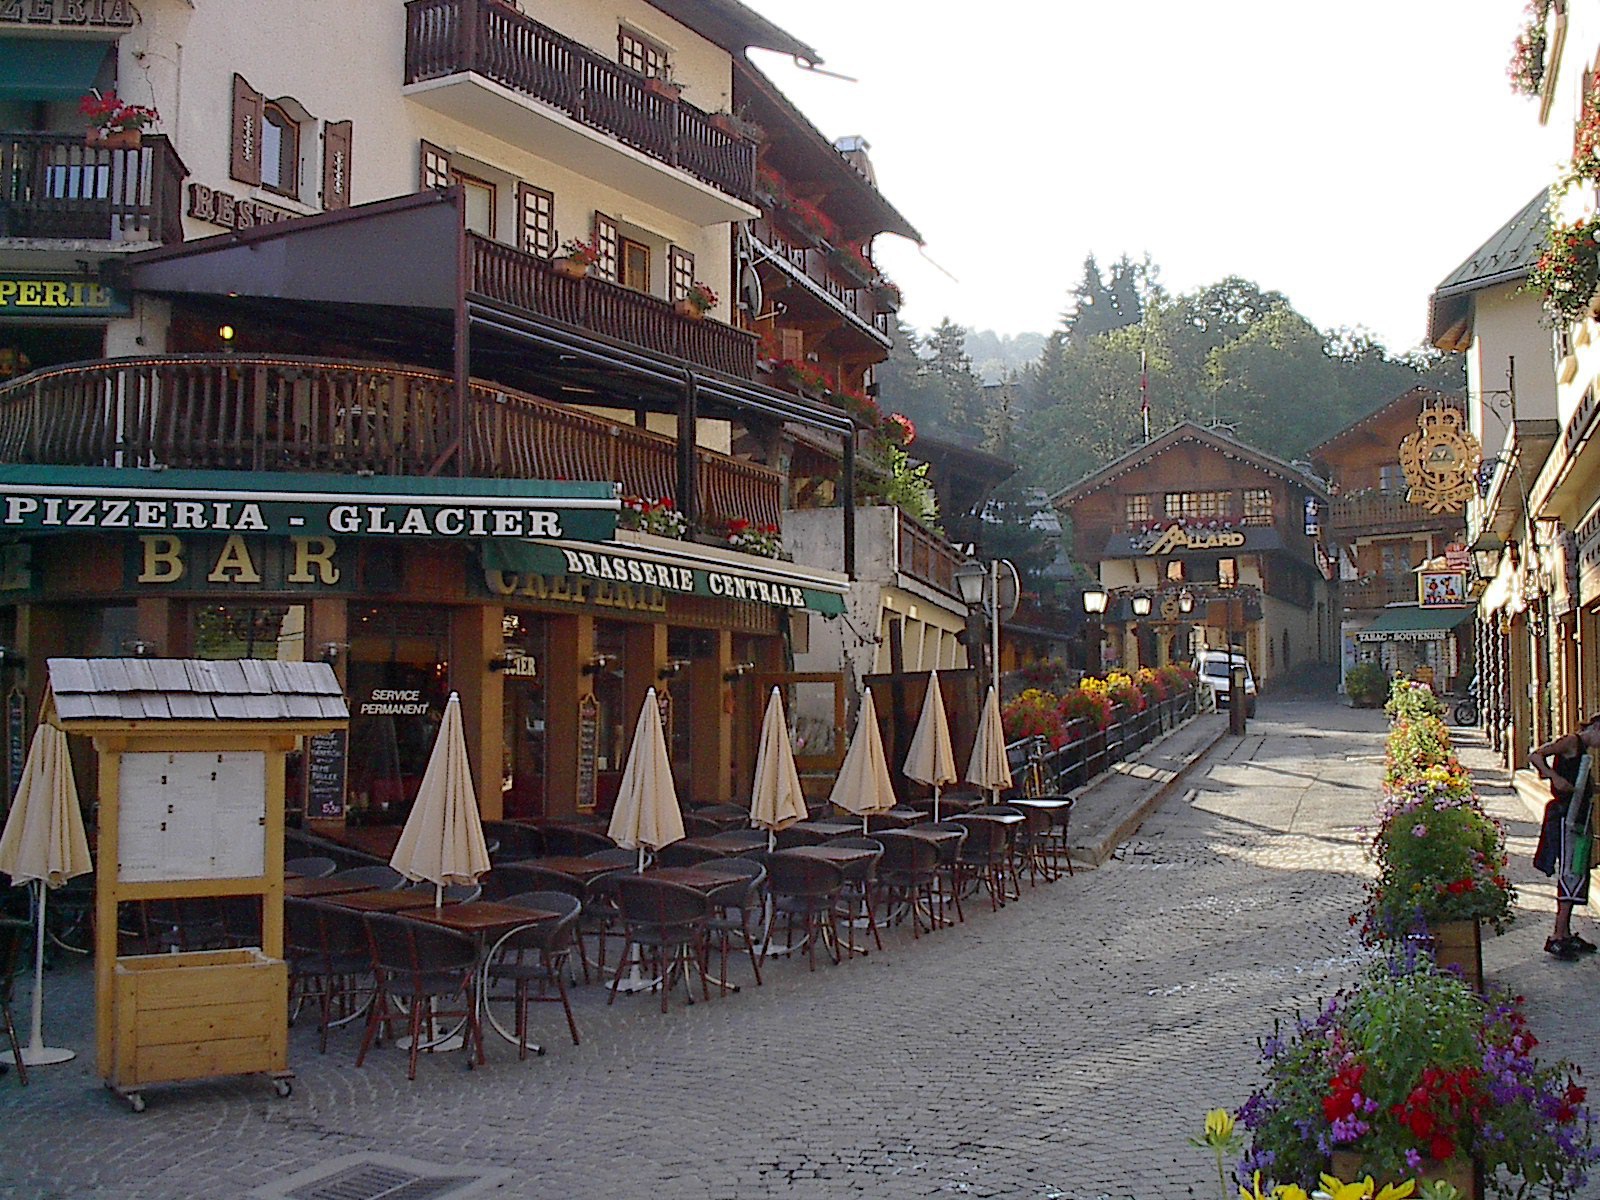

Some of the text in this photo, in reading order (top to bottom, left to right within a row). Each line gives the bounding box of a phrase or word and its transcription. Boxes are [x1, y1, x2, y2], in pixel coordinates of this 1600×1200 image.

[5, 498, 267, 531] PIZZERIA
[329, 505, 563, 537] GLACIER
[137, 534, 341, 585] BAR
[564, 550, 806, 608] BRASSERIE CENTRALE
[360, 702, 430, 715] PERMANENT
[371, 689, 420, 701] SERVICE
